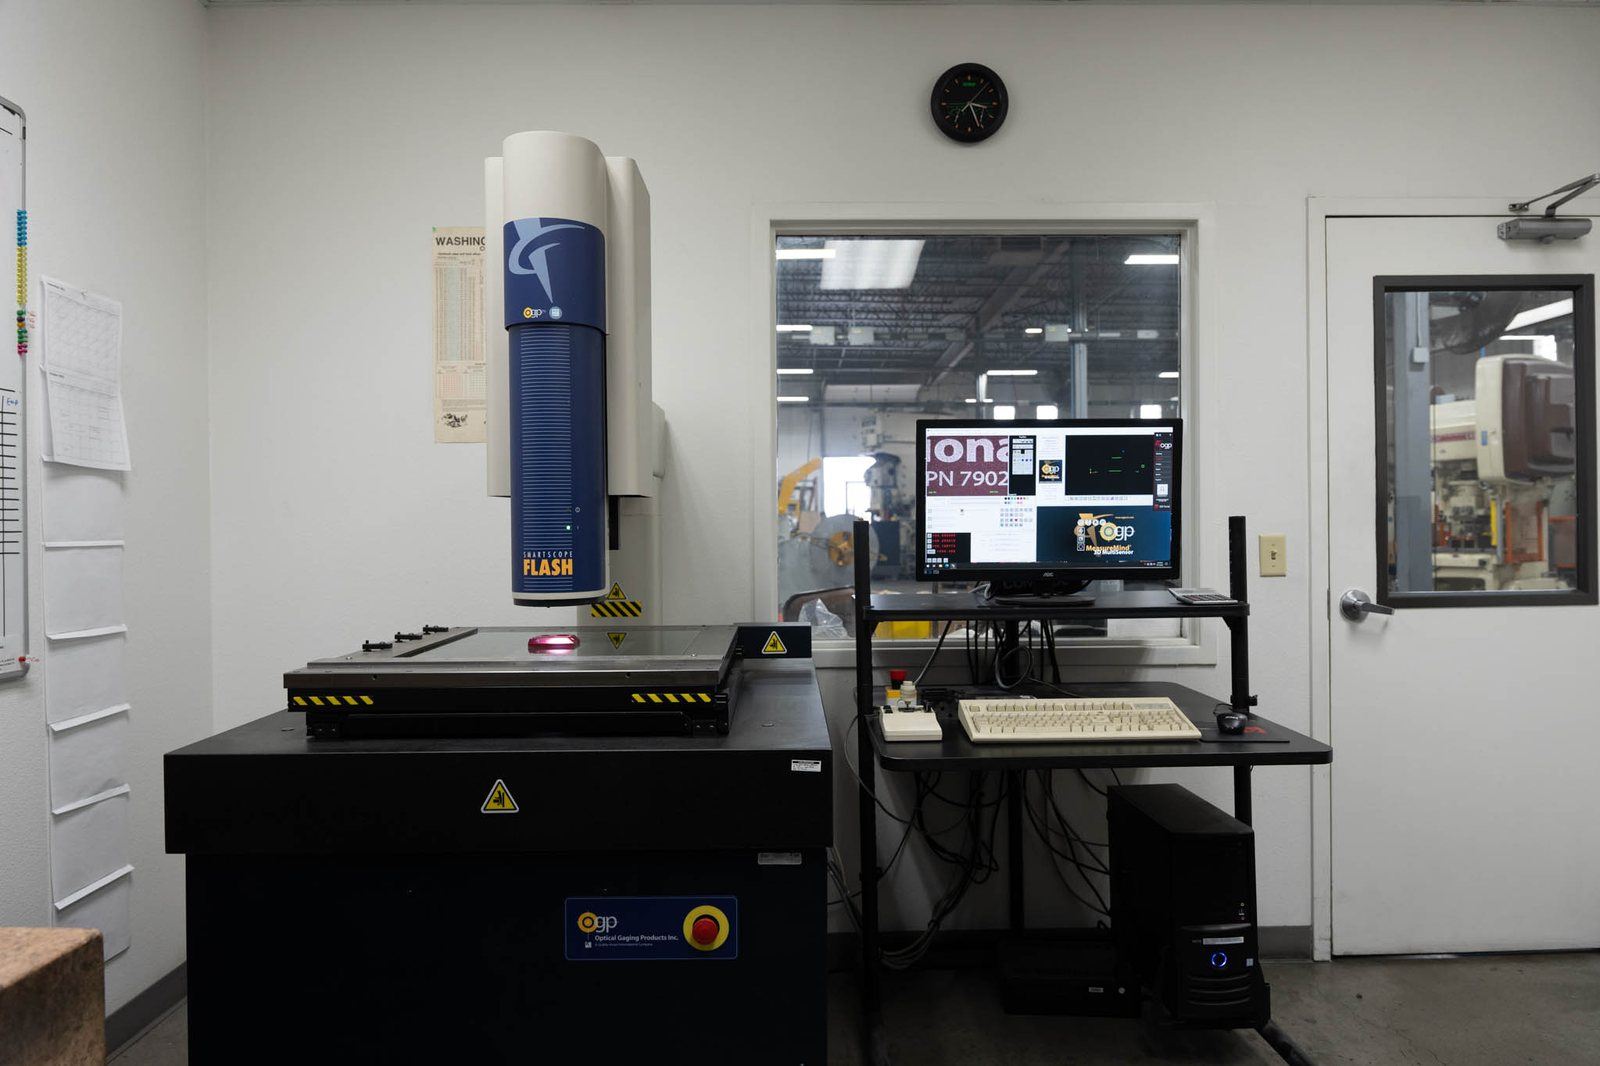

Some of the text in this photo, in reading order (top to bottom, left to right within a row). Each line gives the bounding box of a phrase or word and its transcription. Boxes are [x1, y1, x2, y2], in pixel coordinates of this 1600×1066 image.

[927, 470, 1009, 487] PN 7902
[523, 559, 573, 576] FLASH
